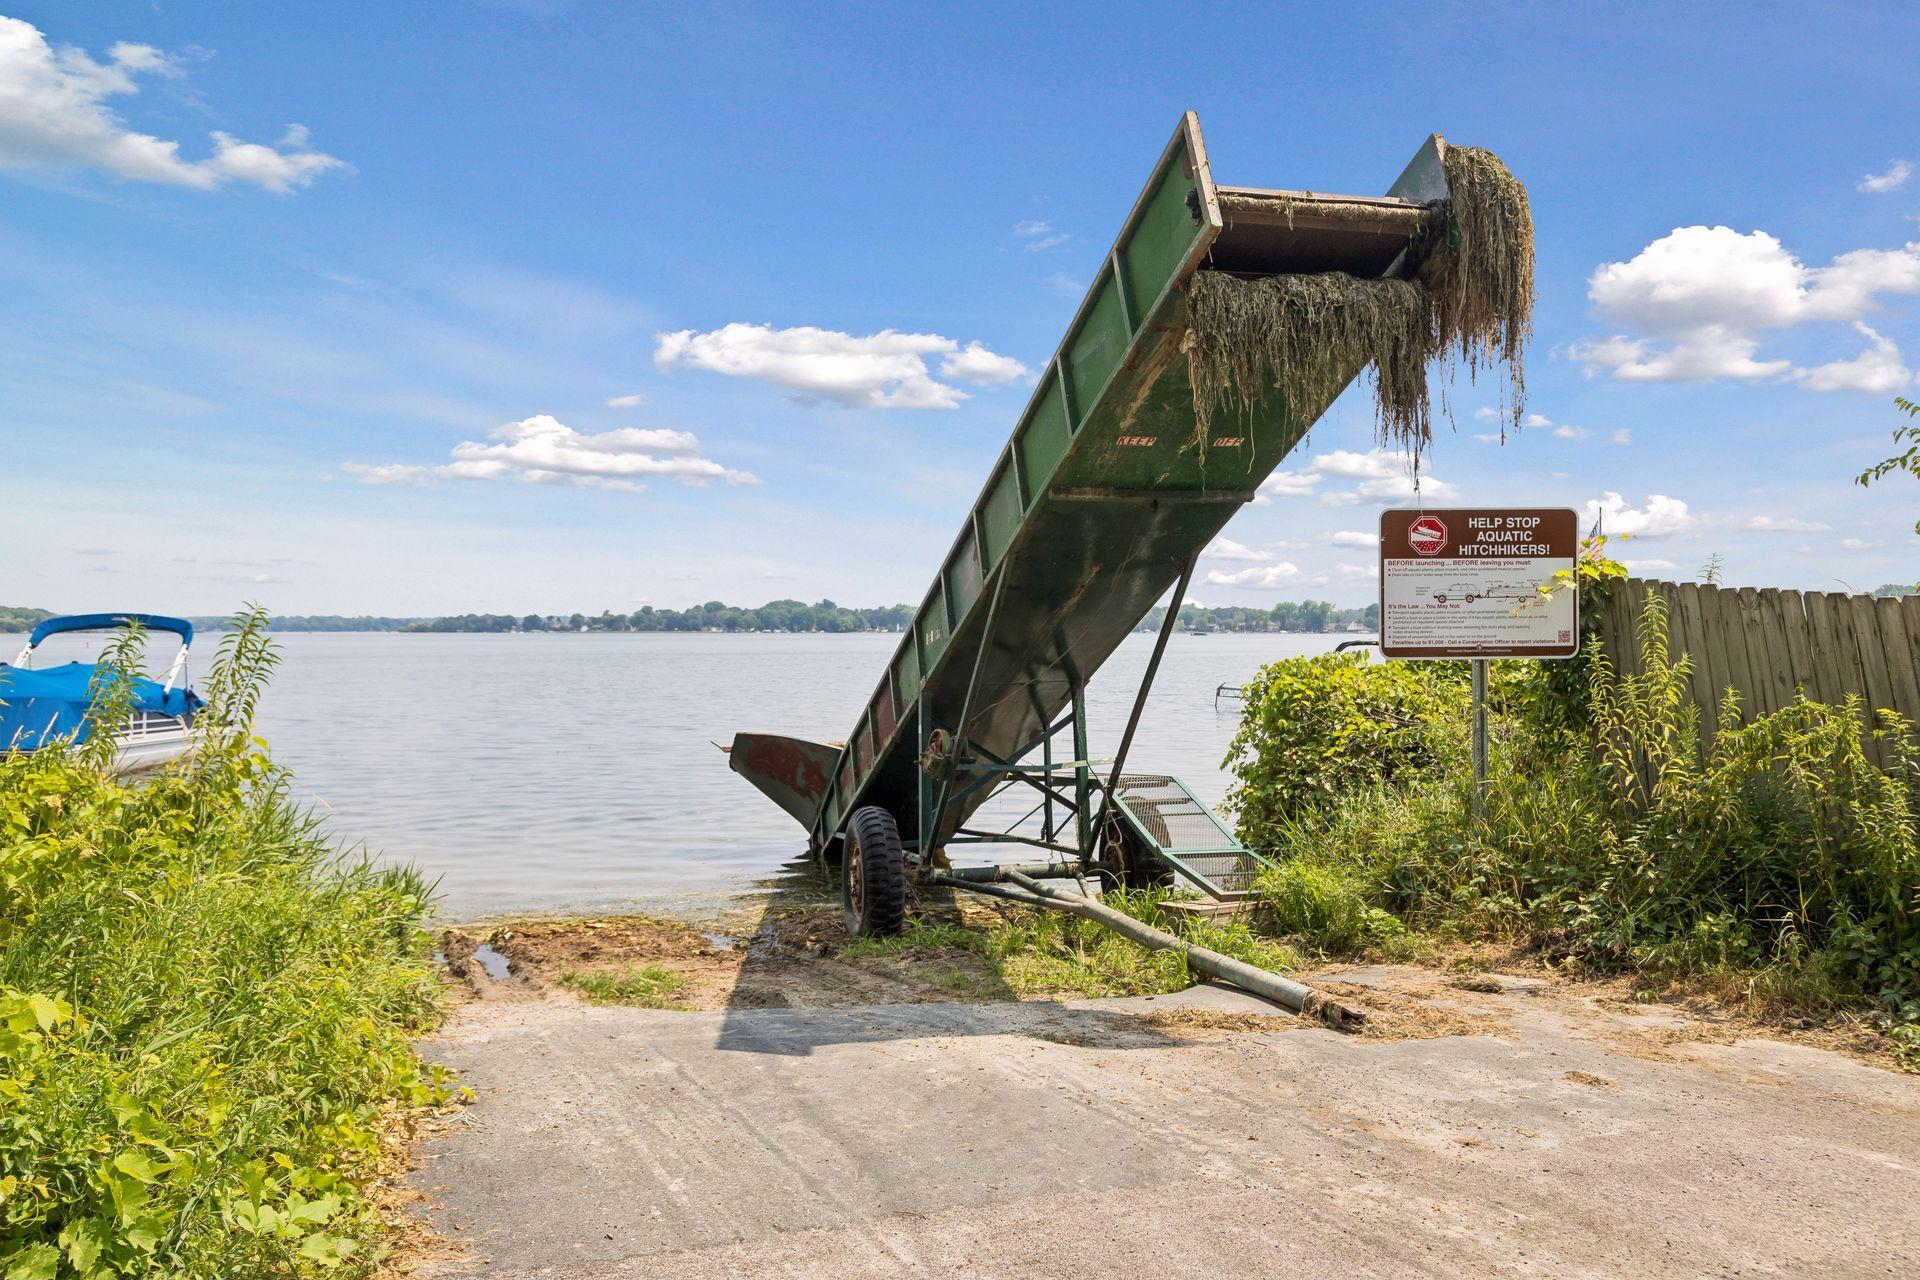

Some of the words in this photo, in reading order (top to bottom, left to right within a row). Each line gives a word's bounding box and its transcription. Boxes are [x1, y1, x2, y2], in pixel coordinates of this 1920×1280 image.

[1116, 436, 1156, 446] KEEP
[1213, 437, 1244, 447] OFF
[1468, 518, 1502, 528] HELP
[1506, 517, 1540, 528] STOP
[1477, 531, 1533, 542] AQUATIC
[1459, 544, 1550, 555] HITCHHIKERS!
